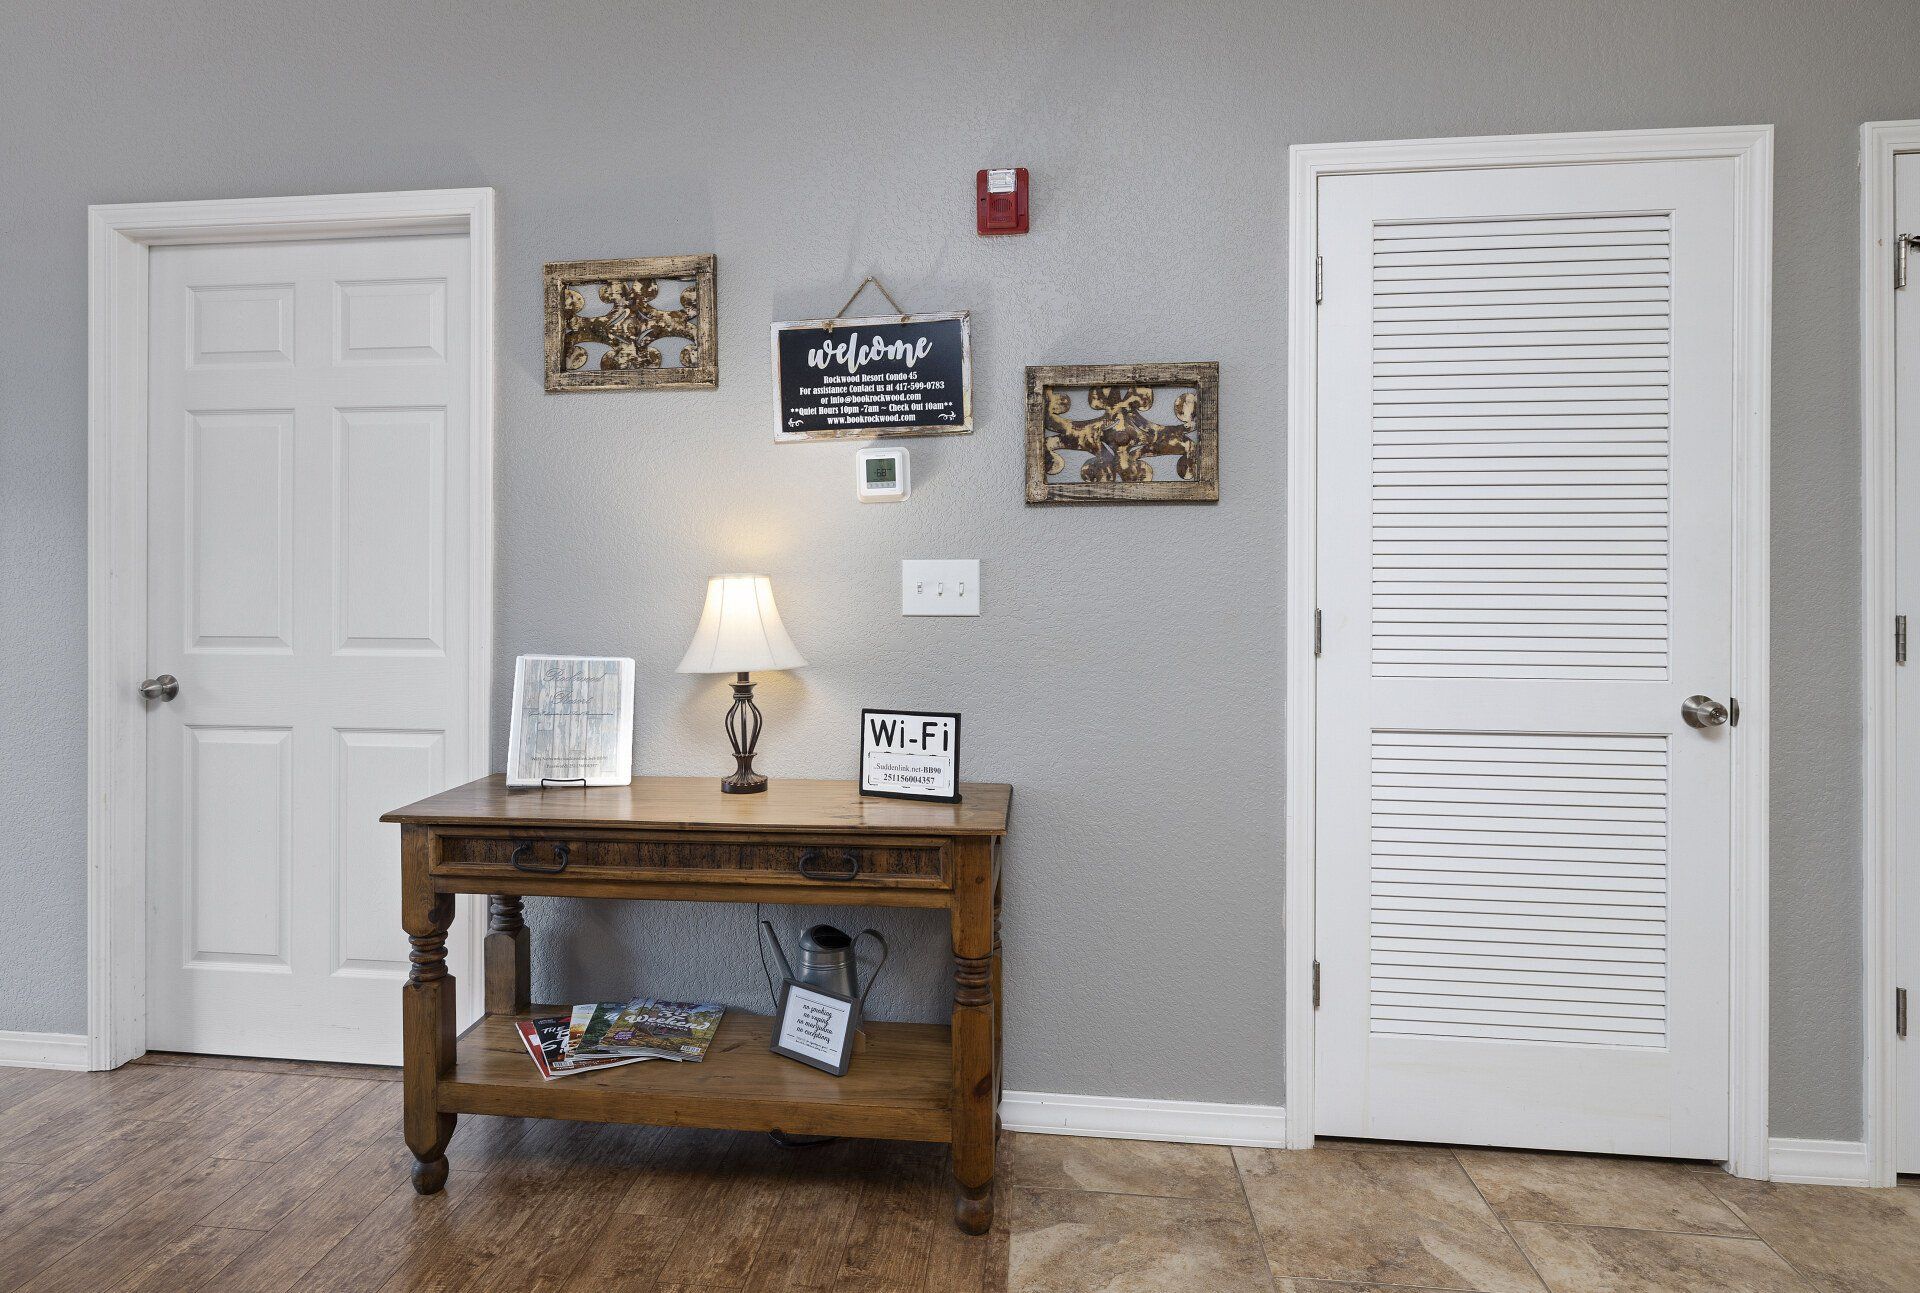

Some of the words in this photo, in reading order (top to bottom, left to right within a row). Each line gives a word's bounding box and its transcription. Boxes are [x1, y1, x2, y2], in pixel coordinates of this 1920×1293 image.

[808, 332, 933, 373] welcome
[823, 374, 860, 384] Rockwood
[862, 373, 884, 382] Resort
[886, 373, 907, 381] Condo
[908, 372, 917, 380] 45
[799, 386, 811, 396] For
[813, 386, 847, 394] assistance
[849, 384, 875, 393] Contact
[886, 383, 893, 391] at
[894, 381, 945, 391] 417-599-0783
[821, 396, 829, 405] or
[830, 392, 921, 404] info@bookrockwood.com
[819, 405, 839, 415] Hours
[840, 404, 859, 415] 10pm
[889, 402, 909, 412] Check
[911, 402, 923, 411] Out
[827, 414, 916, 424] www.bookrockwood.com
[870, 719, 948, 751] Wi-Fi
[884, 774, 935, 784] 251156004357
[811, 1007, 832, 1021] smoking
[812, 1016, 828, 1028] vaping
